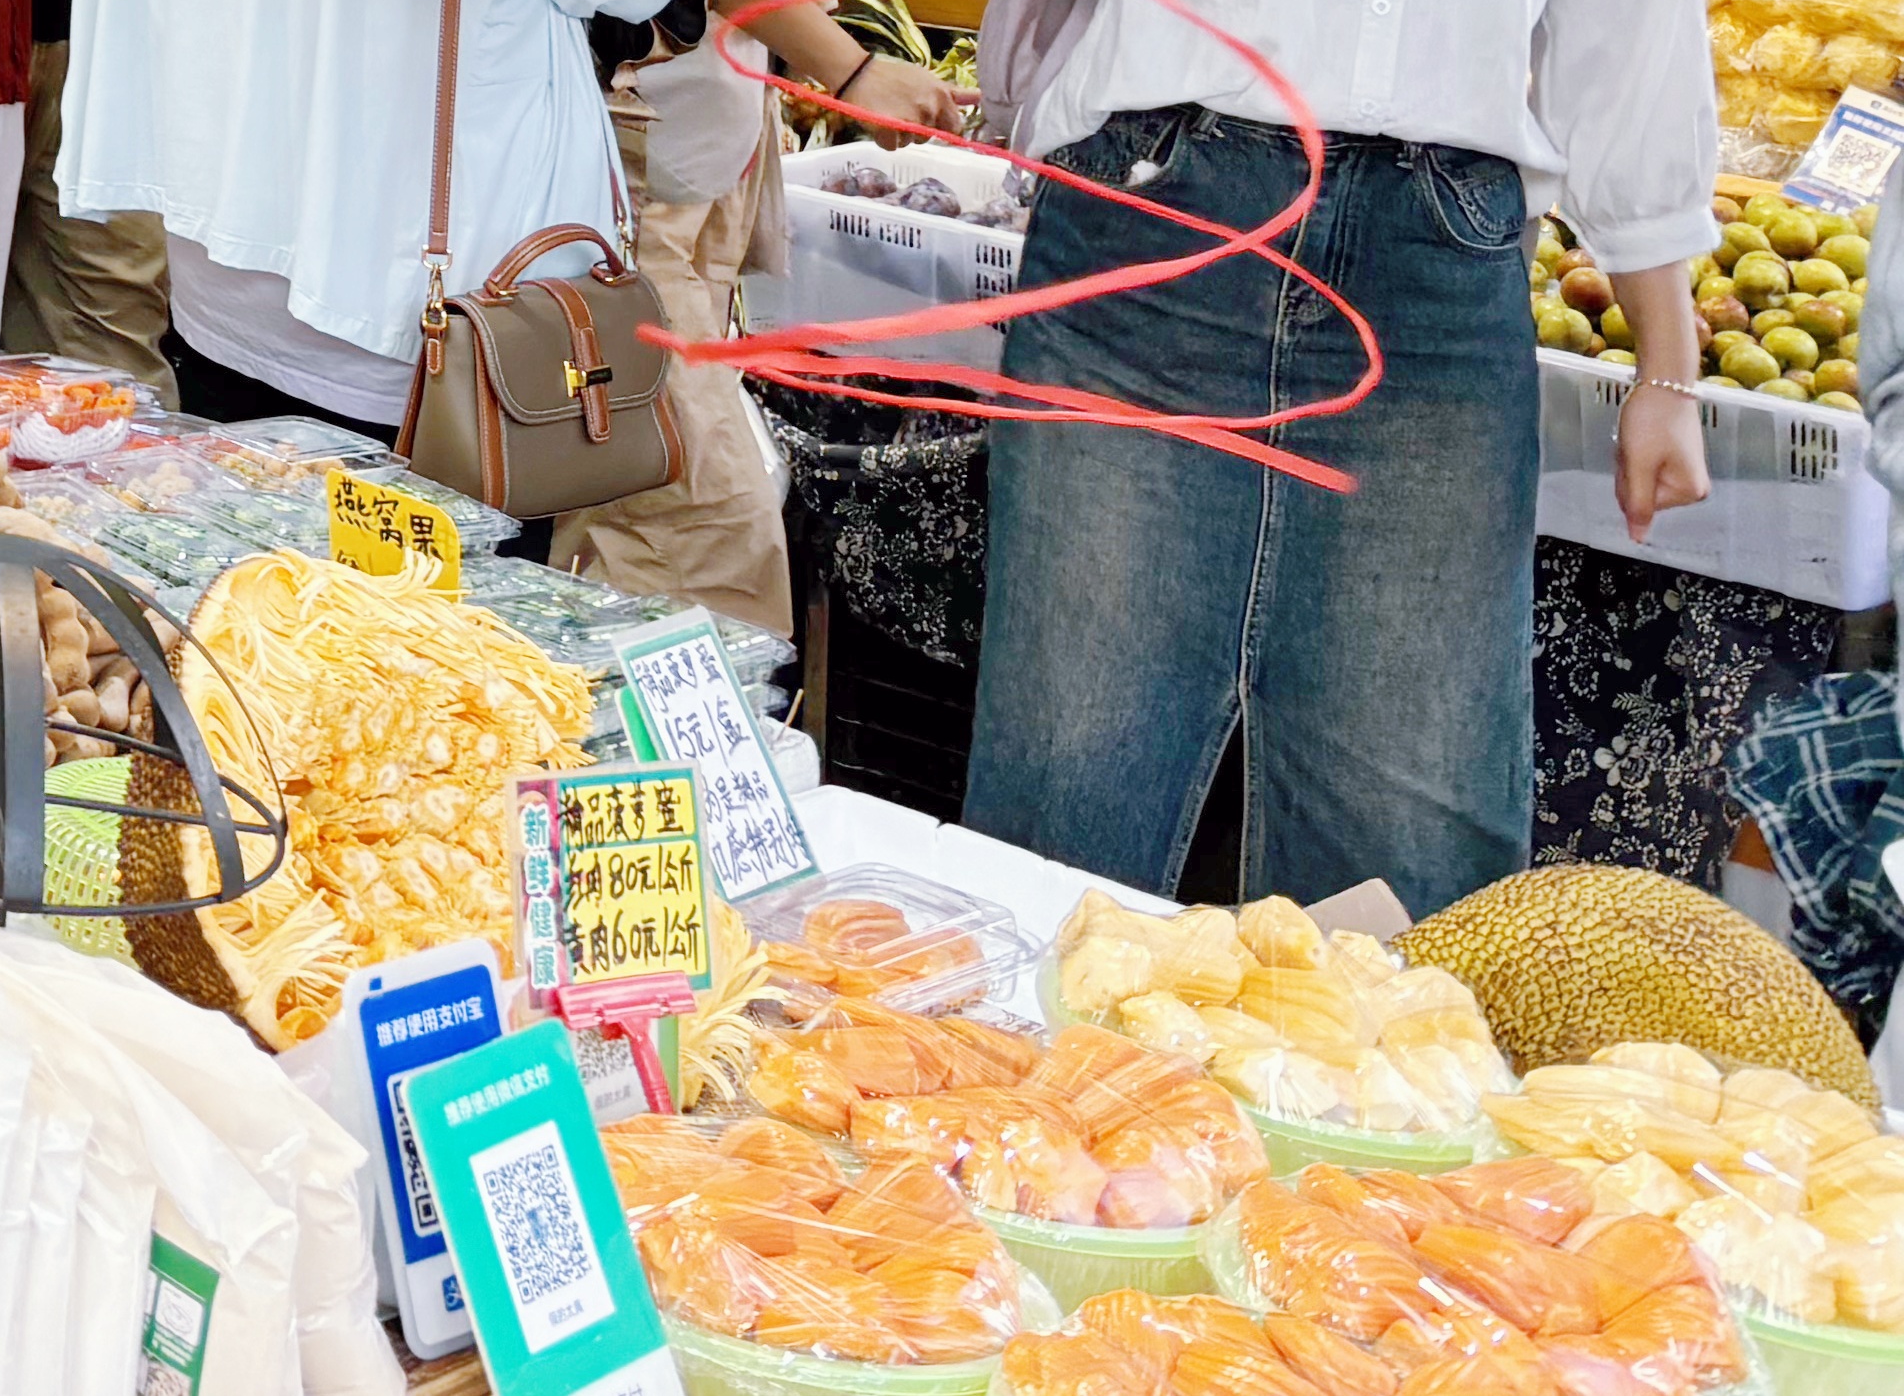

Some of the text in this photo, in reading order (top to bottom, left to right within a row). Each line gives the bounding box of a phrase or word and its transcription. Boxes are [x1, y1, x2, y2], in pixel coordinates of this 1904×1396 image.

[334, 476, 444, 561] 燕窝果
[522, 805, 557, 986] 新鲜健康
[375, 994, 486, 1049] 推荐使用支付宝
